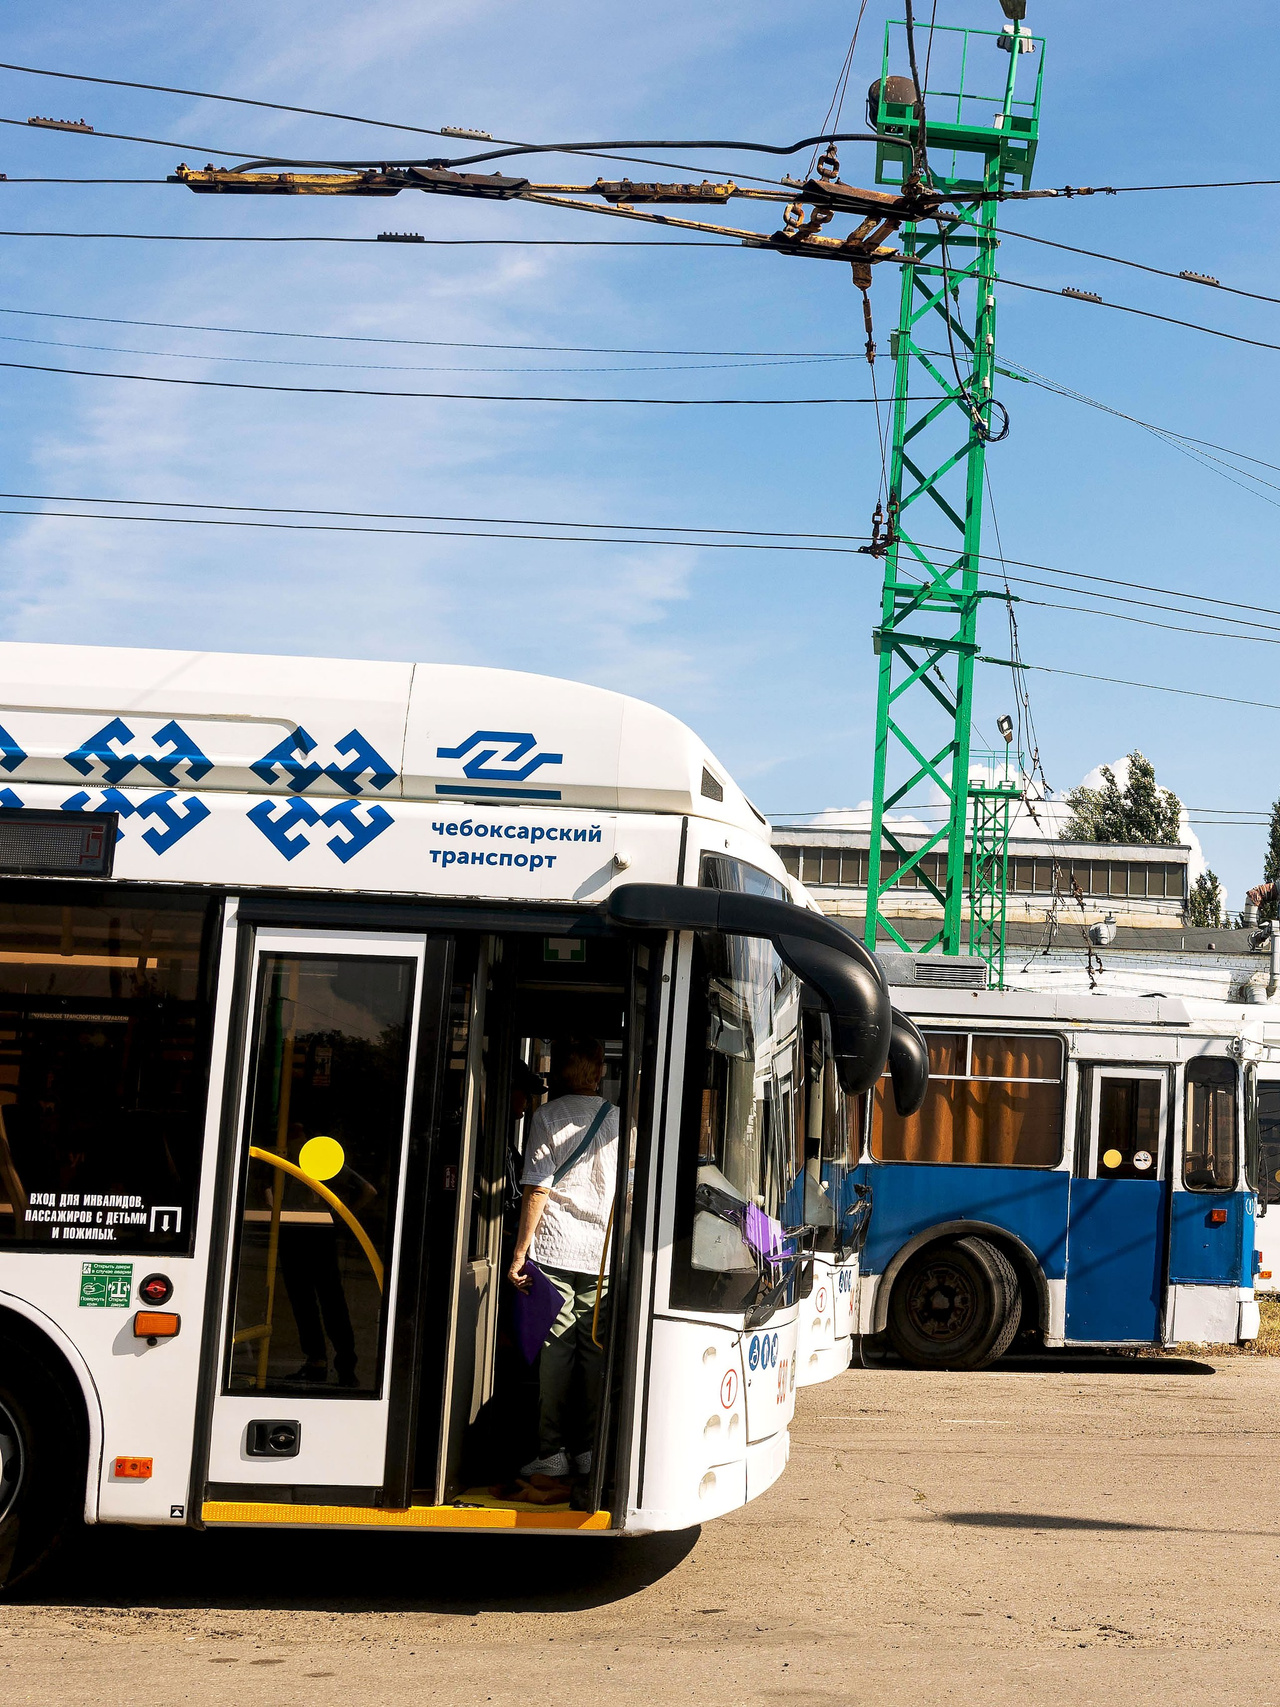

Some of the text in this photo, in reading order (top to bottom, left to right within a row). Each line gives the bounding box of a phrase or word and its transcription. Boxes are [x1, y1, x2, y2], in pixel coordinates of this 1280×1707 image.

[431, 819, 602, 844] чебоксарский
[429, 850, 557, 872] транспорт
[30, 1193, 145, 1210] ВХОД ДЛЯ ИНВАЛИДОВ,
[24, 1209, 148, 1226] ПАССАЖИРОВ С ДЕТЬМИ
[51, 1227, 117, 1241] И ПОЖИЛЫХ.
